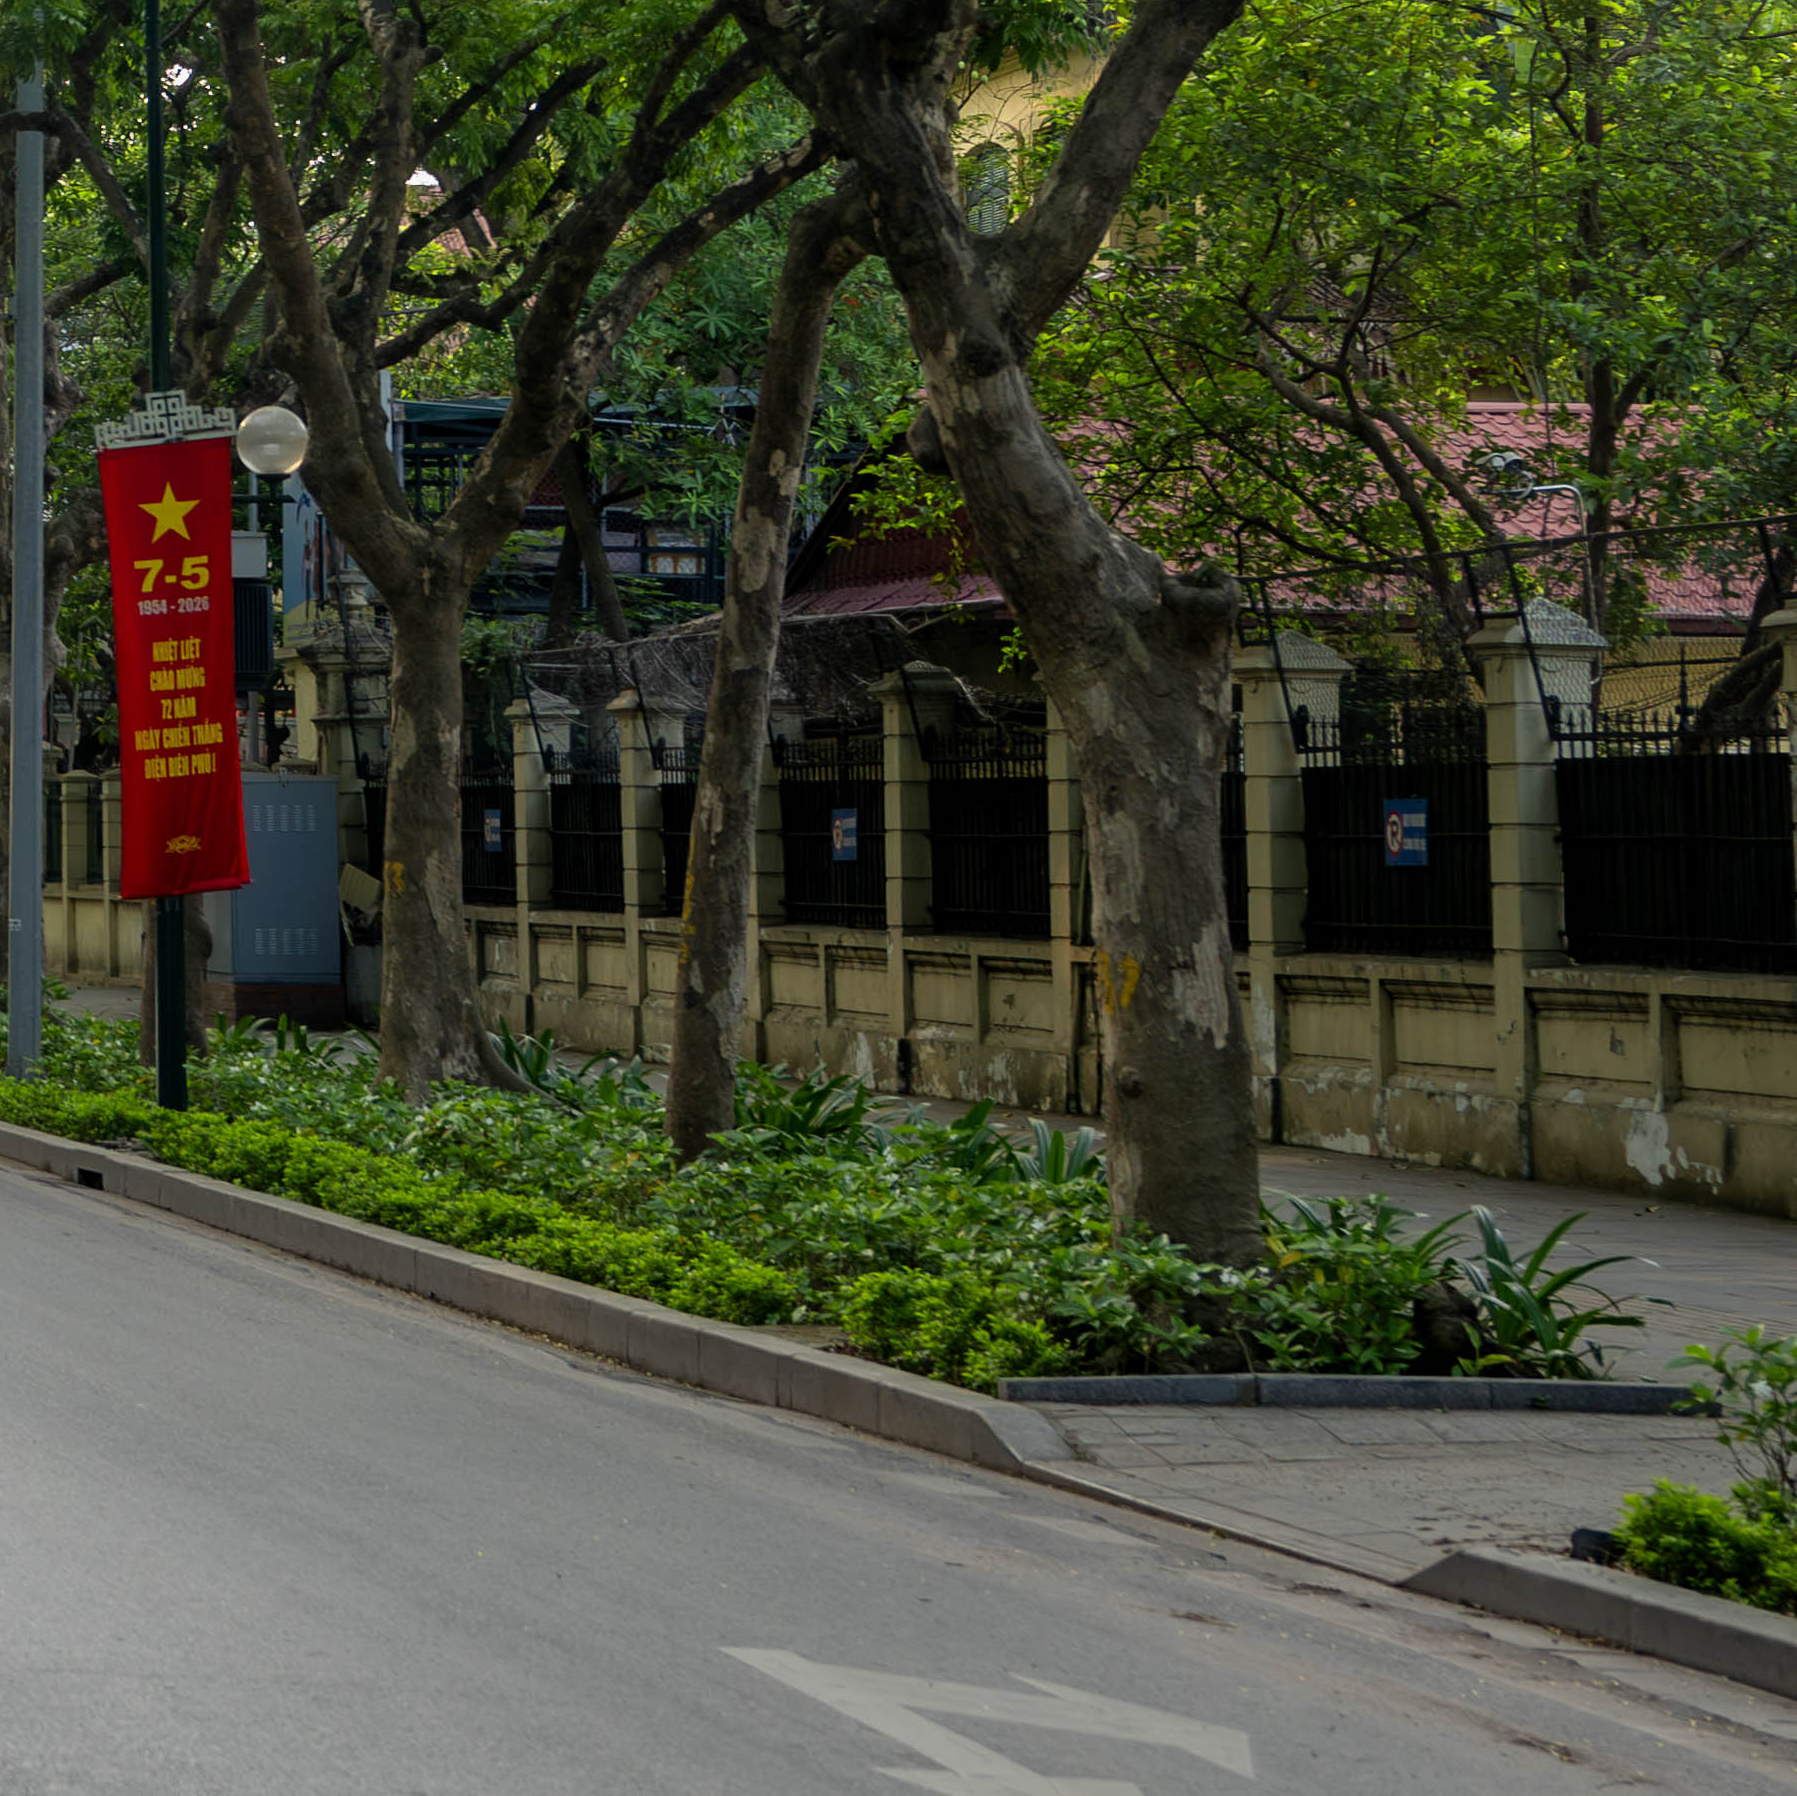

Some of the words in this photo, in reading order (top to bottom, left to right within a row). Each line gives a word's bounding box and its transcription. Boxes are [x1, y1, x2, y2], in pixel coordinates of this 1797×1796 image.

[134, 555, 210, 593] 7-5
[138, 599, 168, 616] 1954
[177, 595, 209, 613] 2026
[161, 698, 173, 719] 72
